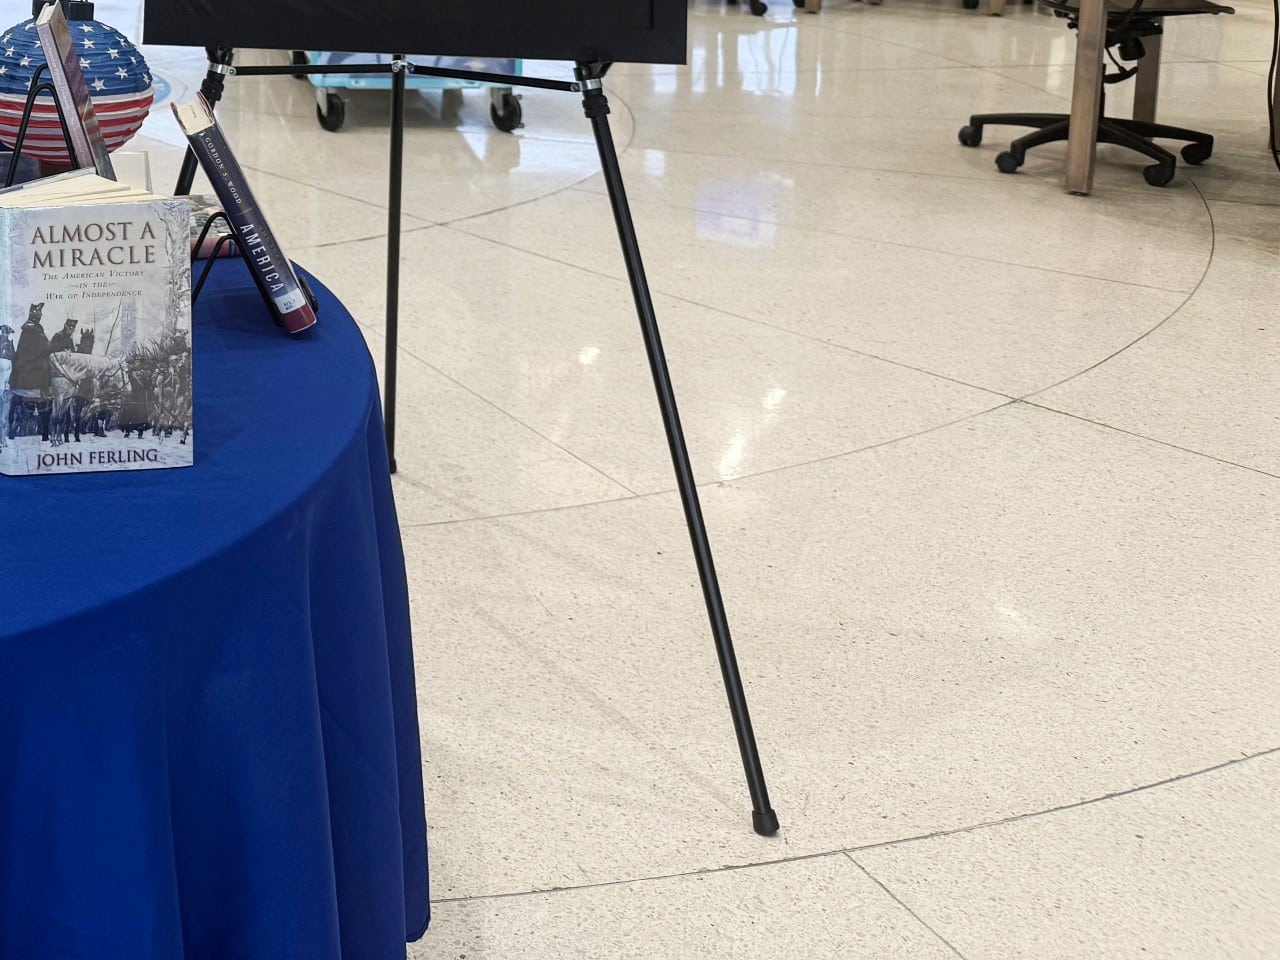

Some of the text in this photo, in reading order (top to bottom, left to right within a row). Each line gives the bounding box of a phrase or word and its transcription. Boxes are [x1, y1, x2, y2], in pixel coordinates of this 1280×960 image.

[30, 221, 156, 245] ALMOST A
[32, 245, 156, 269] MIRACLE
[239, 223, 285, 292] AMERICA
[36, 448, 158, 470] JOHN FERLING
